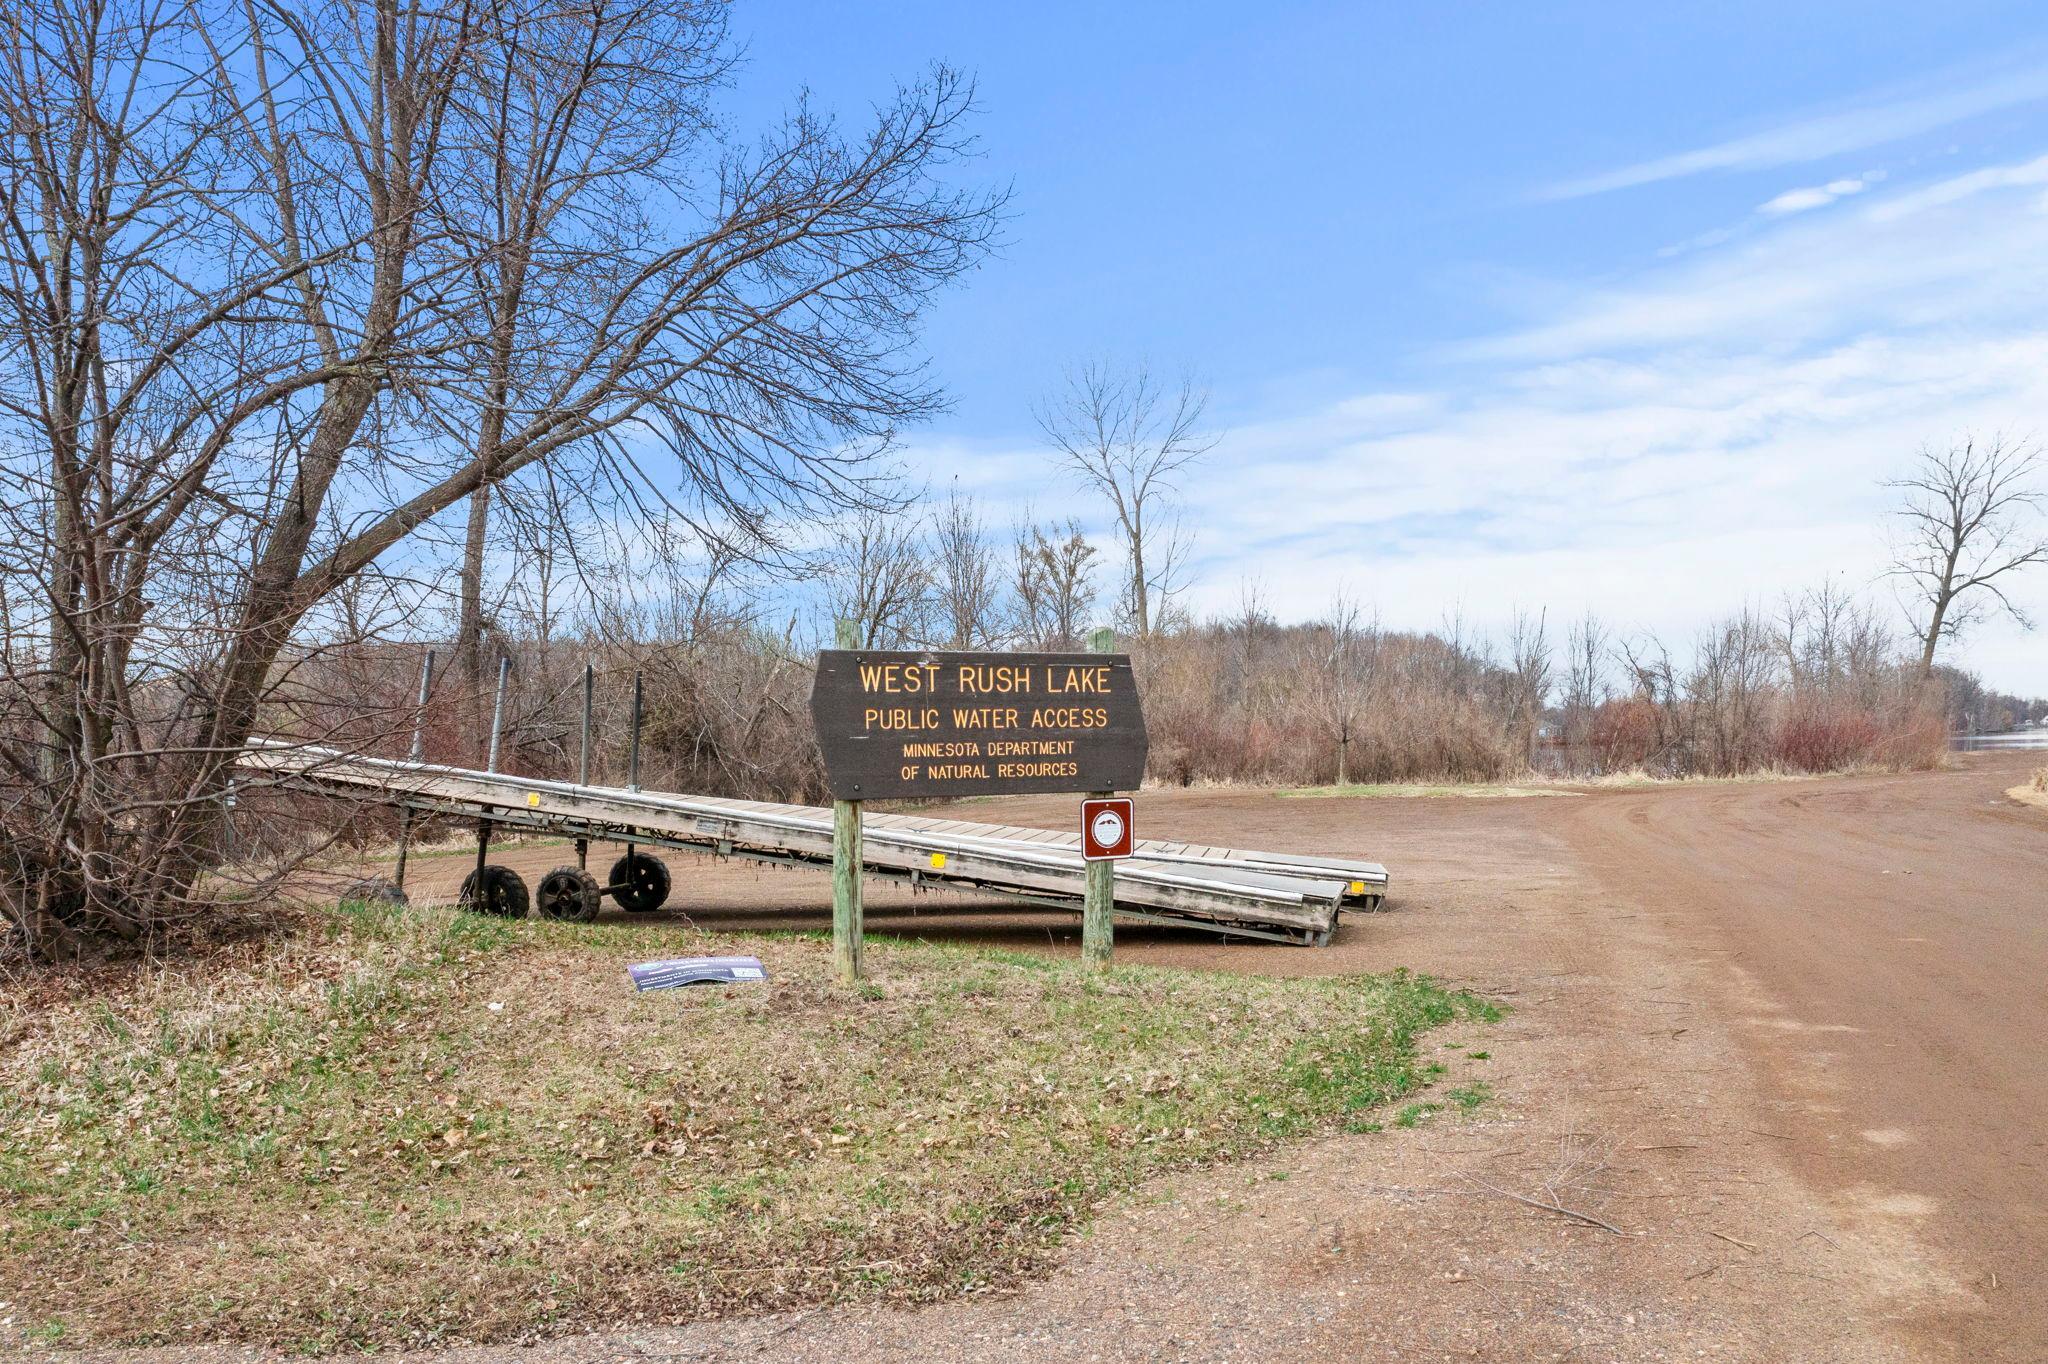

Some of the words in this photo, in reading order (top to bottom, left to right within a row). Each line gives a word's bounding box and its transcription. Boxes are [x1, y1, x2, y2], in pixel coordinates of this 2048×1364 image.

[860, 665, 940, 693] WEST
[959, 666, 1030, 693] RUSH
[1047, 667, 1111, 693] LAKE
[865, 709, 939, 730] PUBLIC
[953, 708, 1018, 729] WATER
[1031, 708, 1107, 728] ACCESS
[903, 742, 980, 758] MINNESOTA
[988, 741, 1074, 756] DEPARTMENT
[901, 765, 920, 780] OF
[928, 764, 990, 779] NATURAL
[998, 762, 1078, 778] RESOURCES
